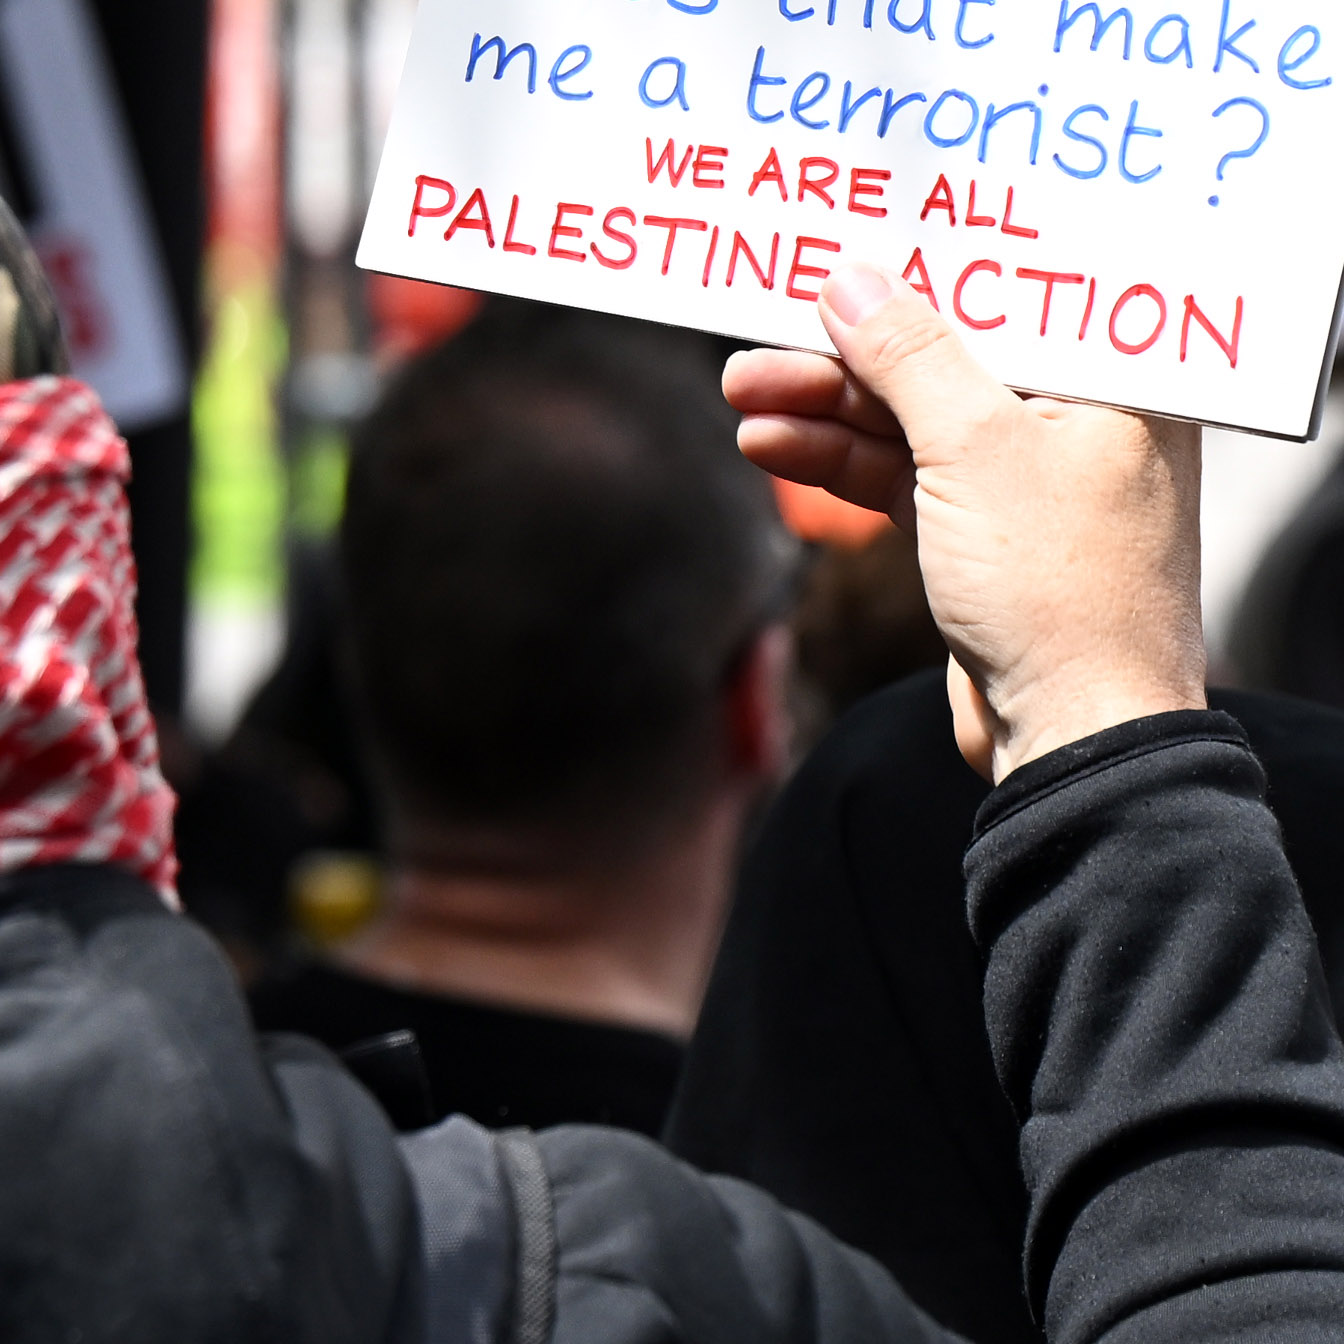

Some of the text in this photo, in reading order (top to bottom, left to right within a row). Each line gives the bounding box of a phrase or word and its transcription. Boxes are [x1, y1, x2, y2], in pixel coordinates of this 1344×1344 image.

[464, 32, 594, 102] me
[637, 56, 691, 113] a
[644, 136, 1039, 240] WE ARE ALL
[407, 174, 1244, 369] PALESTINE ACTION
